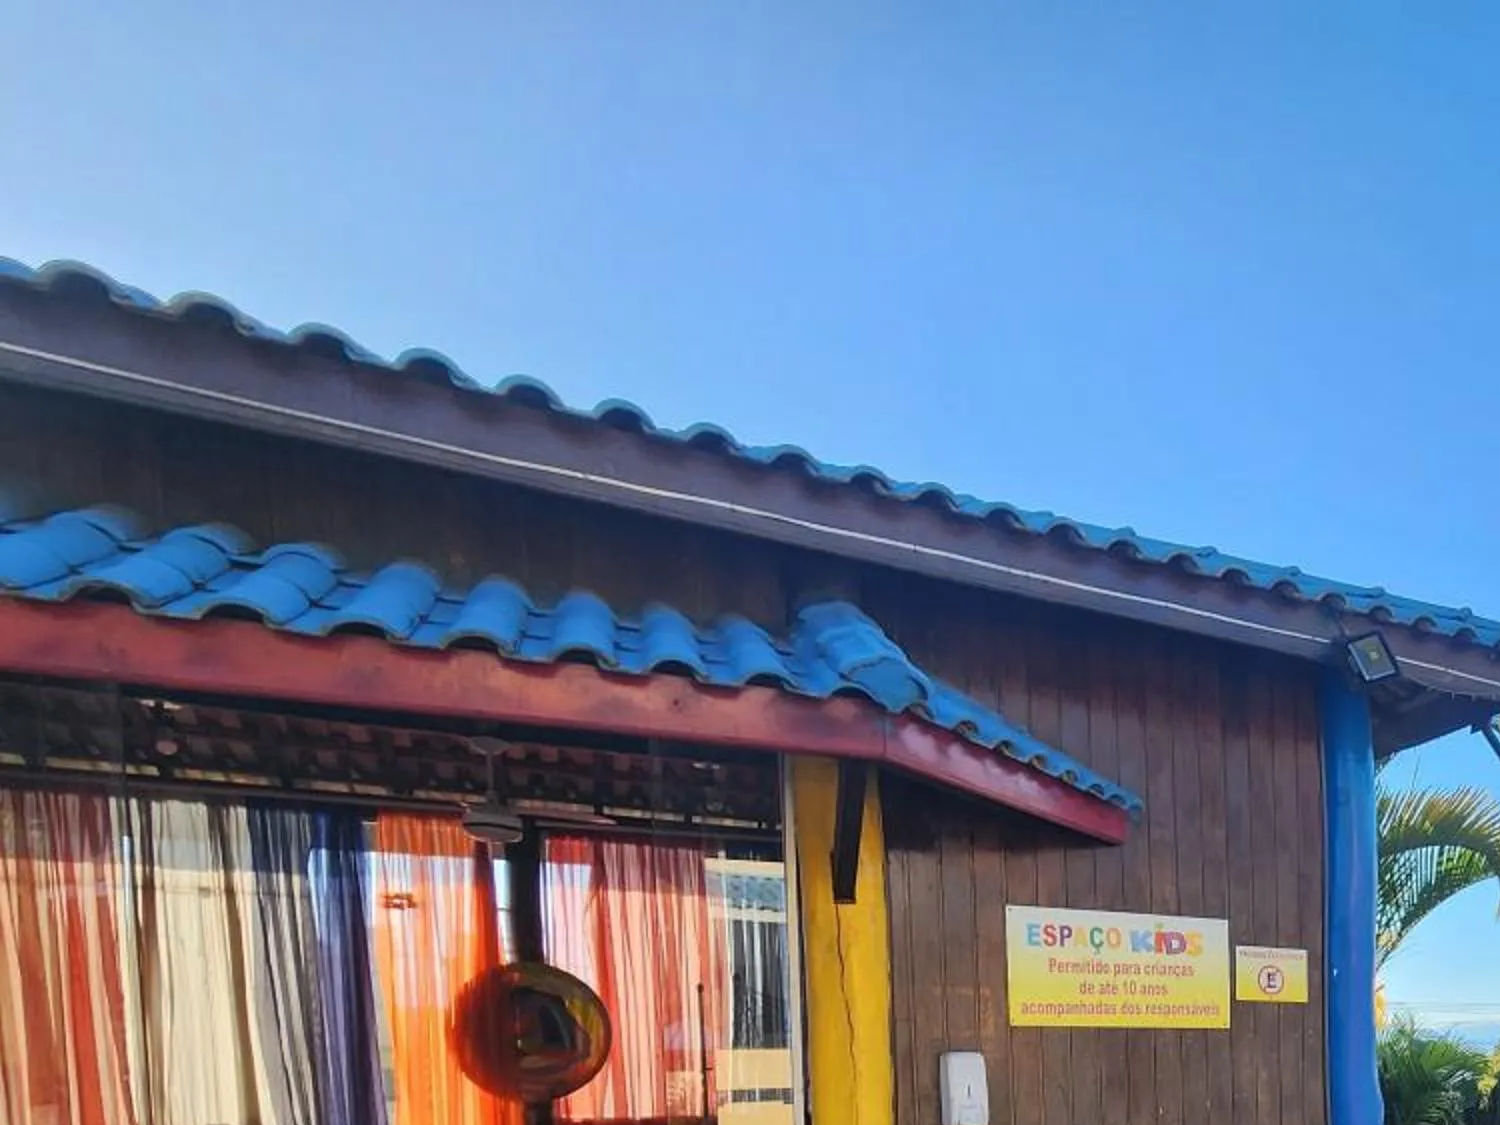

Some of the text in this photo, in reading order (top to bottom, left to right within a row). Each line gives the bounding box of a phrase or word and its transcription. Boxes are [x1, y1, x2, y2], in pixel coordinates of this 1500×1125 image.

[1026, 923, 1121, 954] ESPAÇO
[1048, 958, 1194, 977] Permitido para crianças
[1079, 980, 1095, 994] de
[1123, 980, 1137, 994] 10
[1140, 983, 1168, 995] anos
[1120, 1001, 1142, 1015] dos
